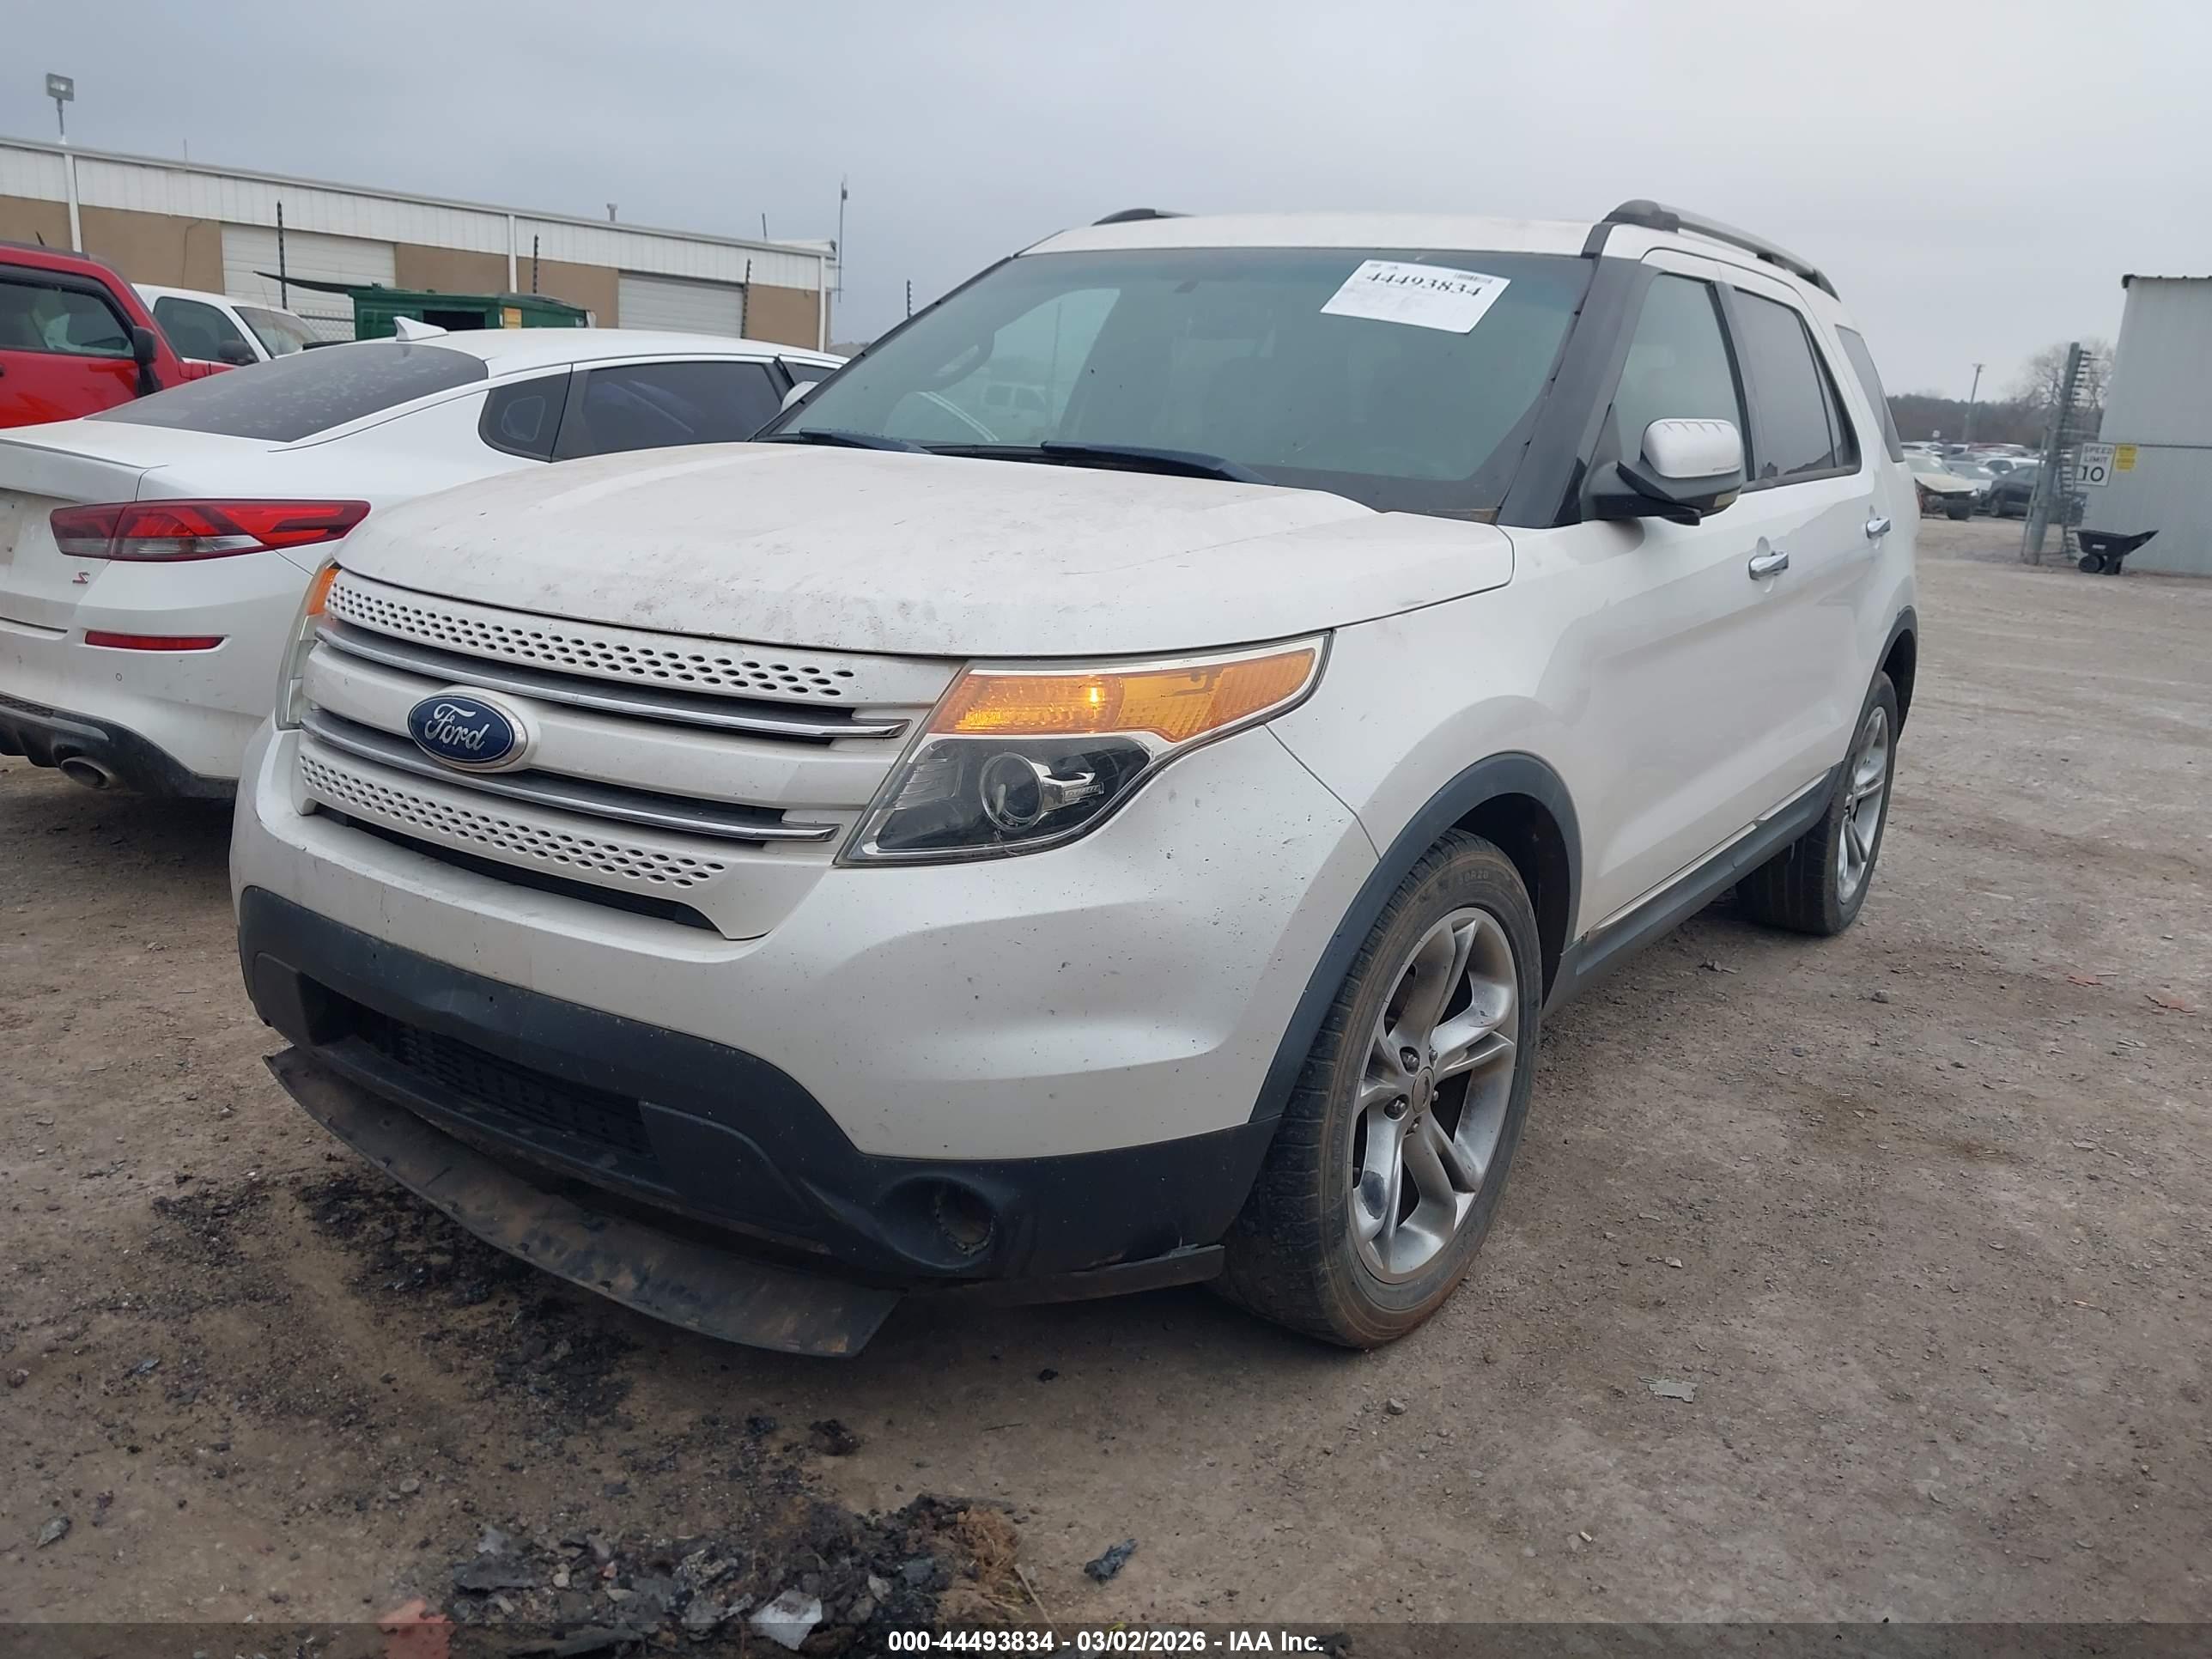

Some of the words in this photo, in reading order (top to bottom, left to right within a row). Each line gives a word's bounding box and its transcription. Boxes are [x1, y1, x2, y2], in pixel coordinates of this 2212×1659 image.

[1367, 272, 1483, 296] 44493834
[2083, 446, 2113, 454] SPEED
[2083, 455, 2108, 464] LIMIT
[2081, 466, 2105, 482] 10
[72, 571, 90, 584] S
[424, 703, 490, 750] Ford
